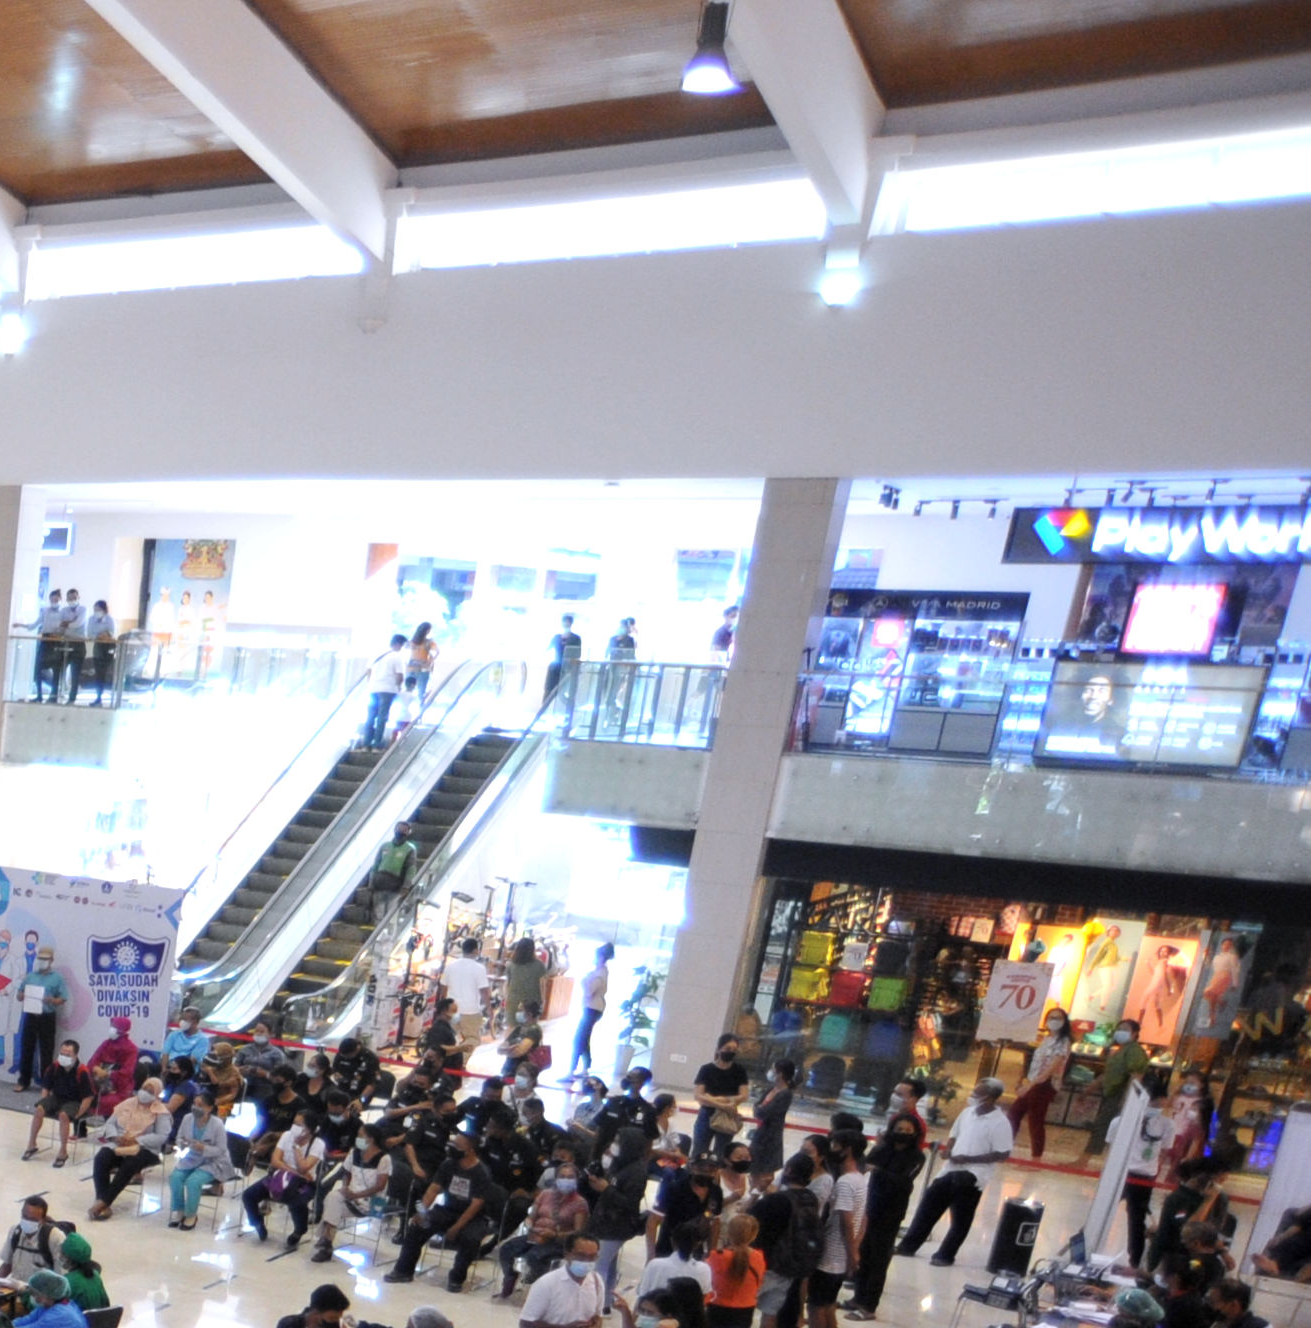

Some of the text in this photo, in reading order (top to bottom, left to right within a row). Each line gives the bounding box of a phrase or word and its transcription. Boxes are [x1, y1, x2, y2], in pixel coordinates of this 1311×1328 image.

[1091, 513, 1199, 562] Play
[945, 600, 1001, 610] MADRID
[89, 974, 158, 987] SAYA SUDAH
[97, 989, 150, 1002] DIVAKSIN
[997, 983, 1037, 1011] 70
[97, 1004, 150, 1018] COVID-19
